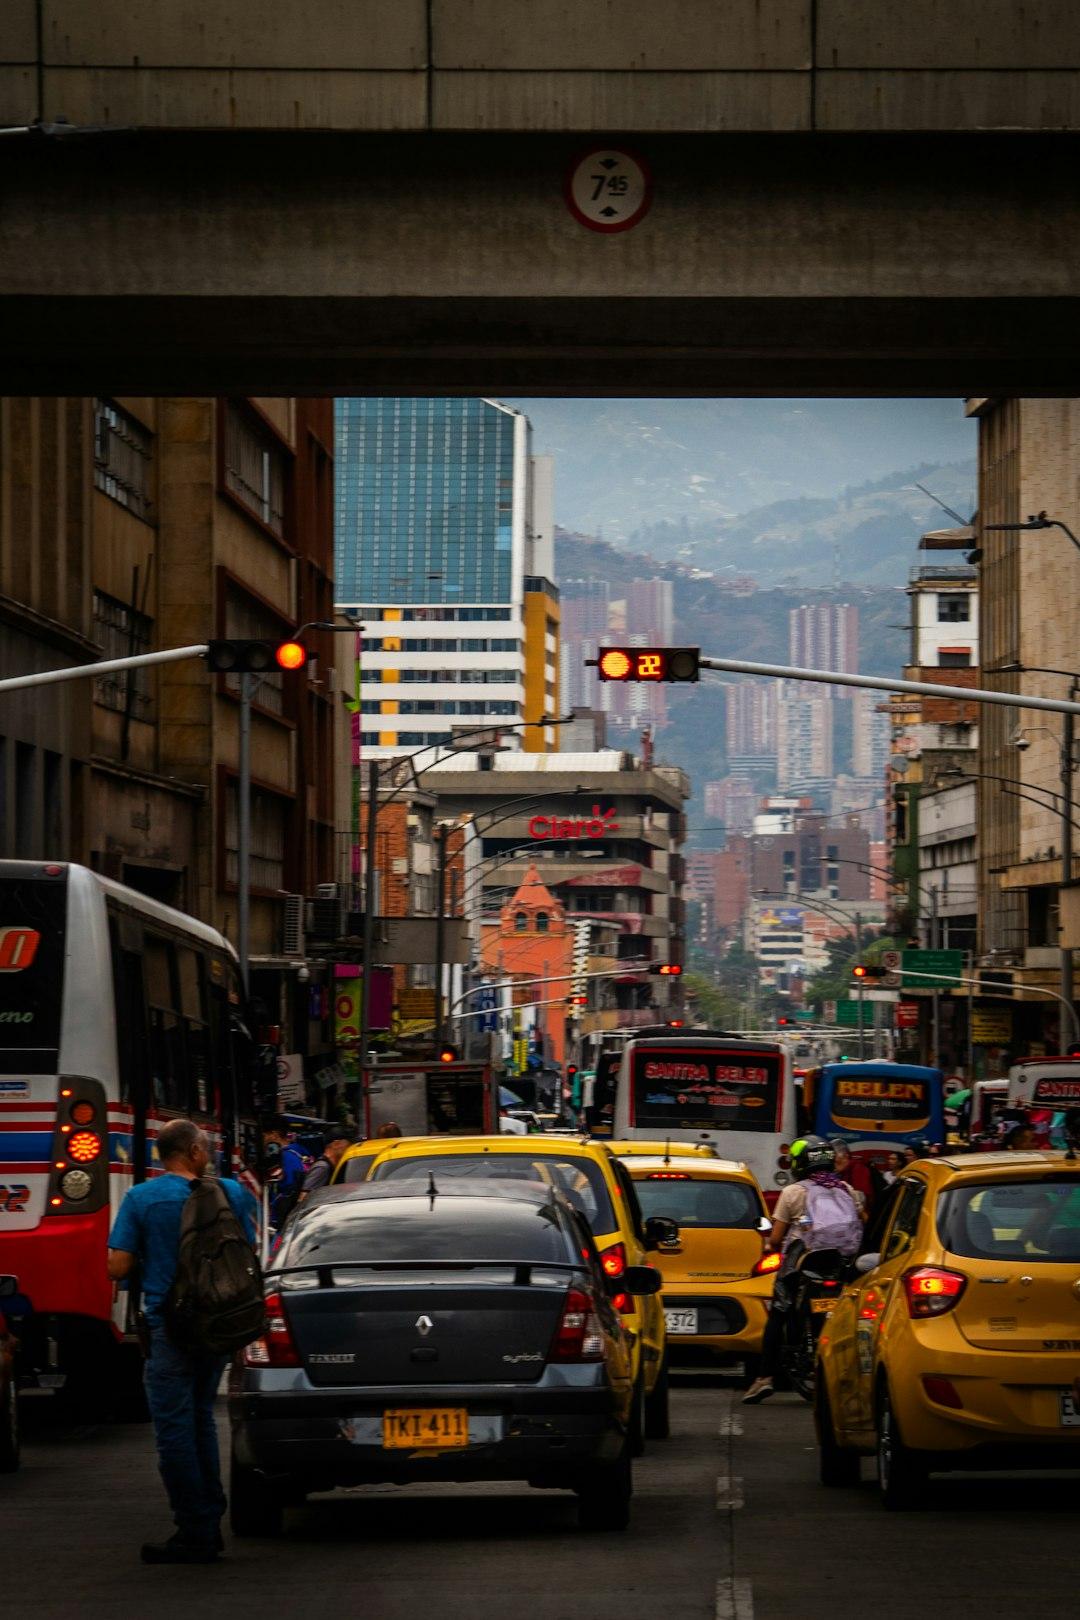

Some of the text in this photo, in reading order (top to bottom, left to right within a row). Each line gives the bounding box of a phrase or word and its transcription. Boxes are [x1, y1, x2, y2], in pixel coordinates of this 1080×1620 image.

[528, 815, 605, 839] Claro
[714, 1065, 769, 1085] BELEN
[836, 1080, 925, 1100] BELEN
